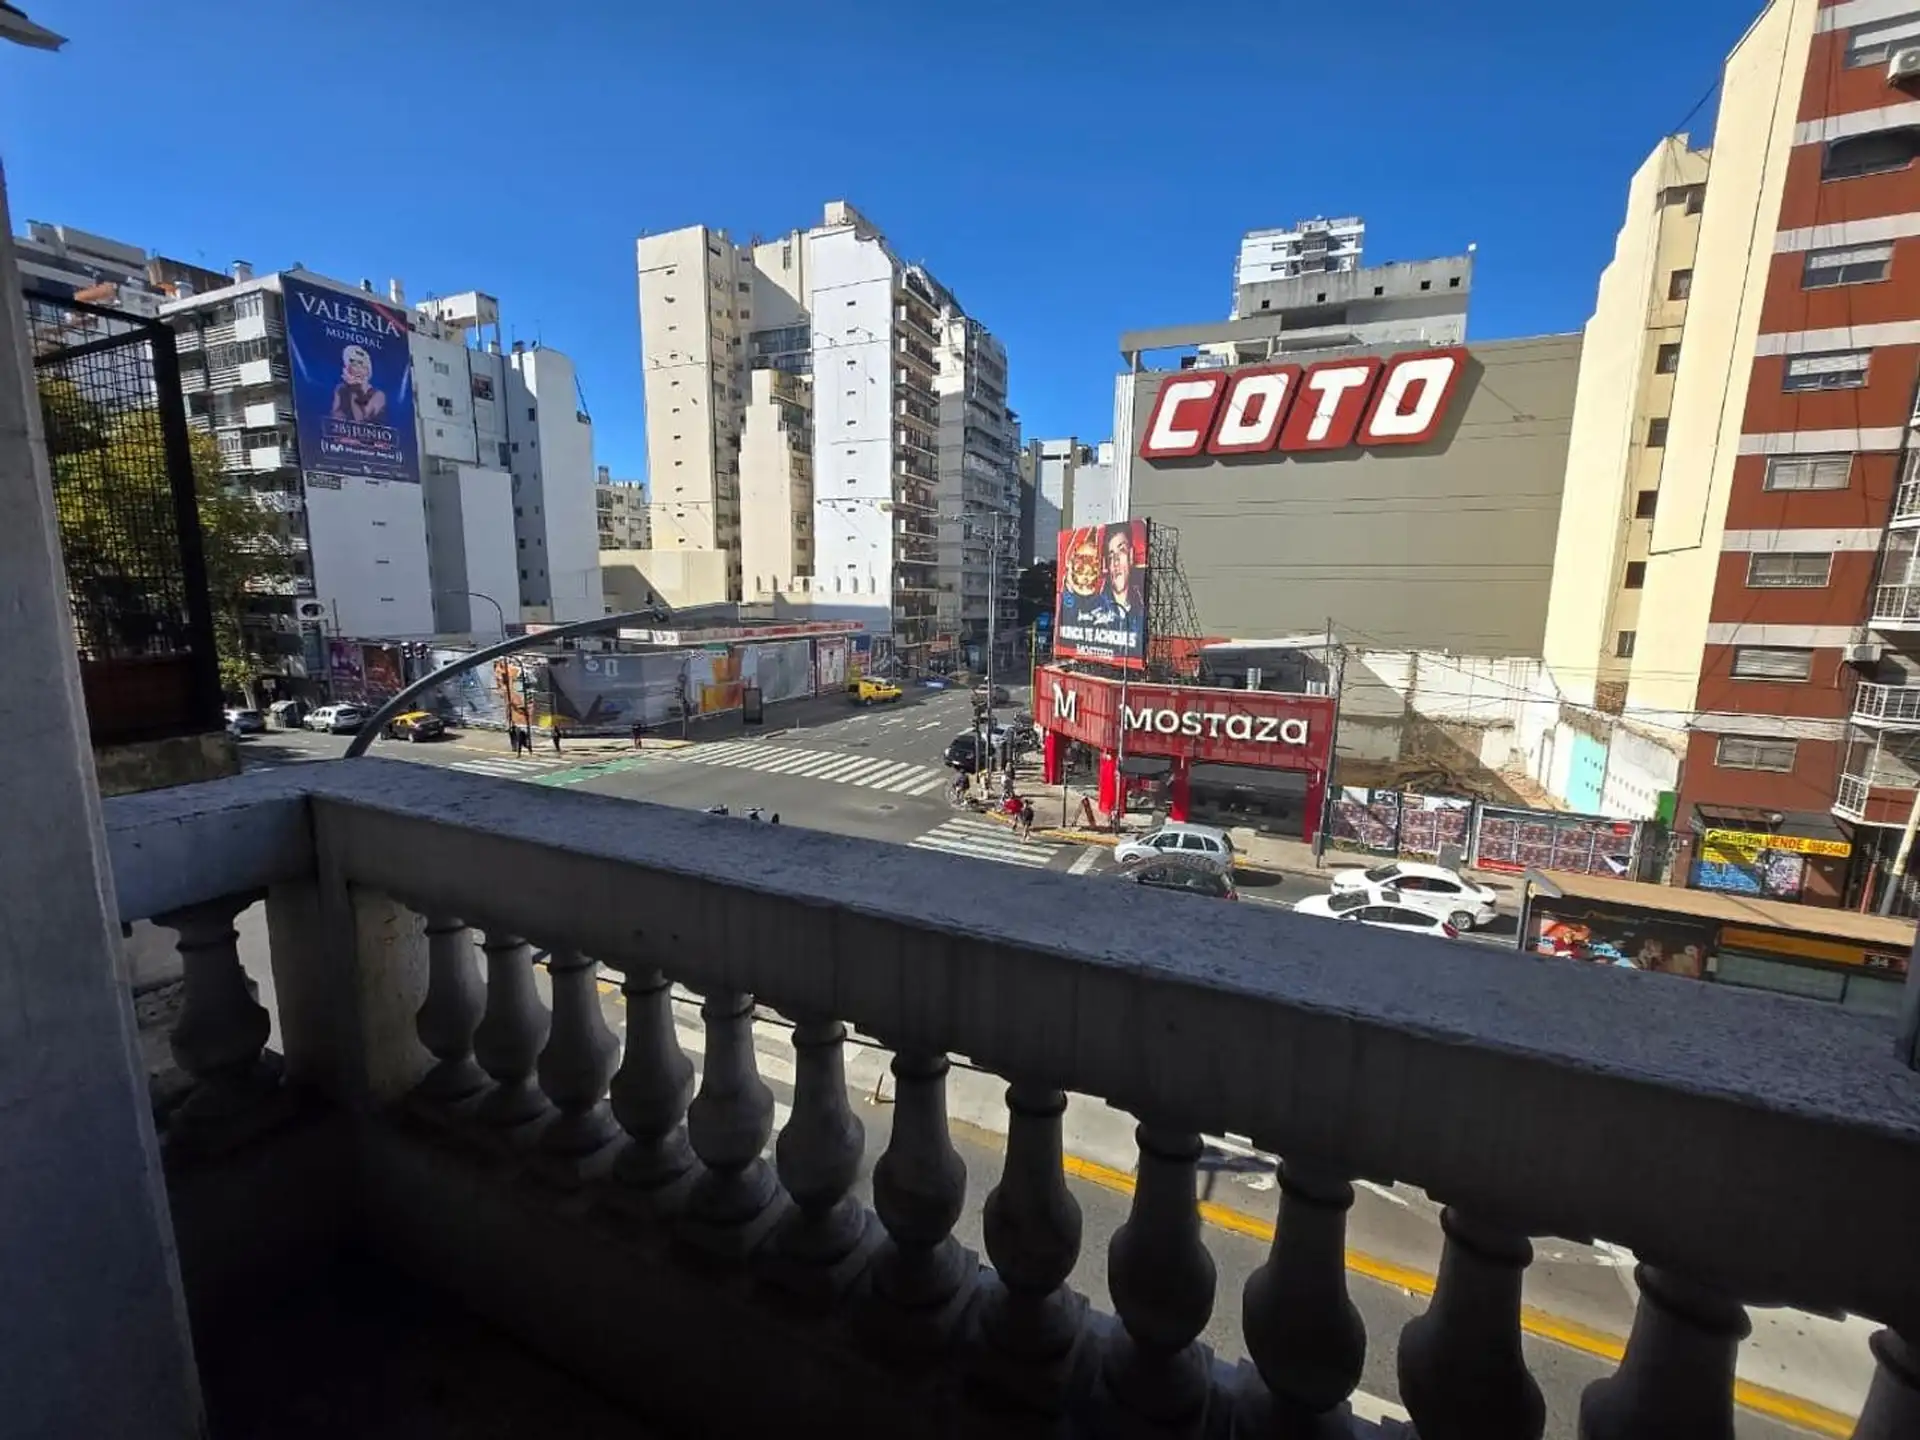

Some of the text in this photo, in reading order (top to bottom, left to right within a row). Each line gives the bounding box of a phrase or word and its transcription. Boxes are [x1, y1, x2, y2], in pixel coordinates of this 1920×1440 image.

[325, 325, 383, 350] MUNDIAL
[1148, 356, 1456, 450] COTO
[1052, 682, 1077, 723] M
[1766, 833, 1805, 850] VENDE
